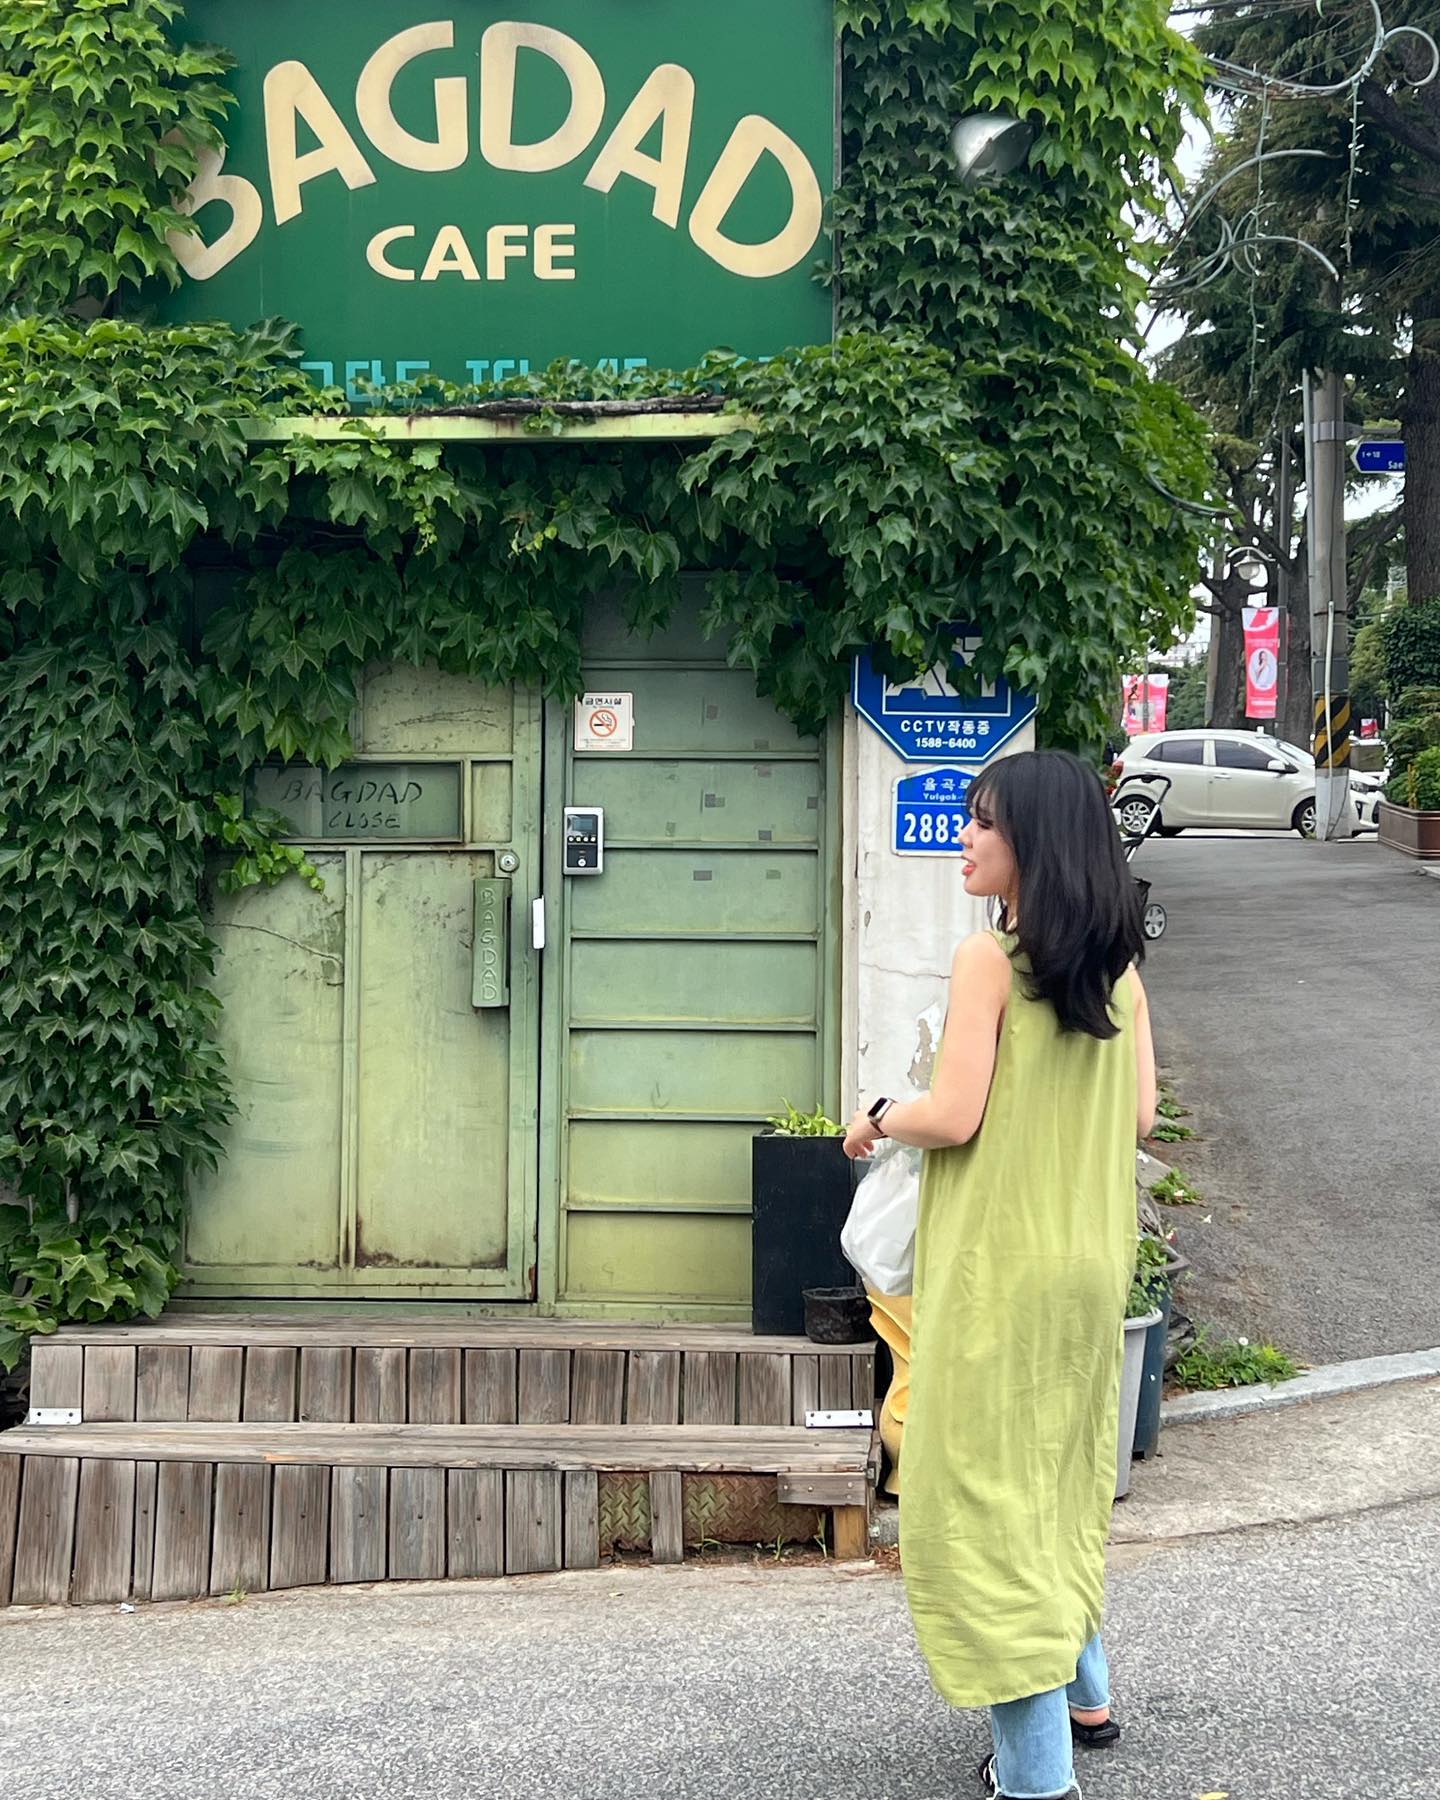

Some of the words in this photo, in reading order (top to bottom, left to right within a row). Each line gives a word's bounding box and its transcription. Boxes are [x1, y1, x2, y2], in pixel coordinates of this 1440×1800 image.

[159, 20, 822, 280] BAGDAD
[366, 223, 576, 280] CAFE
[914, 737, 977, 749] 1588-6400
[281, 780, 423, 804] BAGDAD
[328, 811, 402, 829] CLOSE
[480, 887, 498, 1001] BAGDAD
